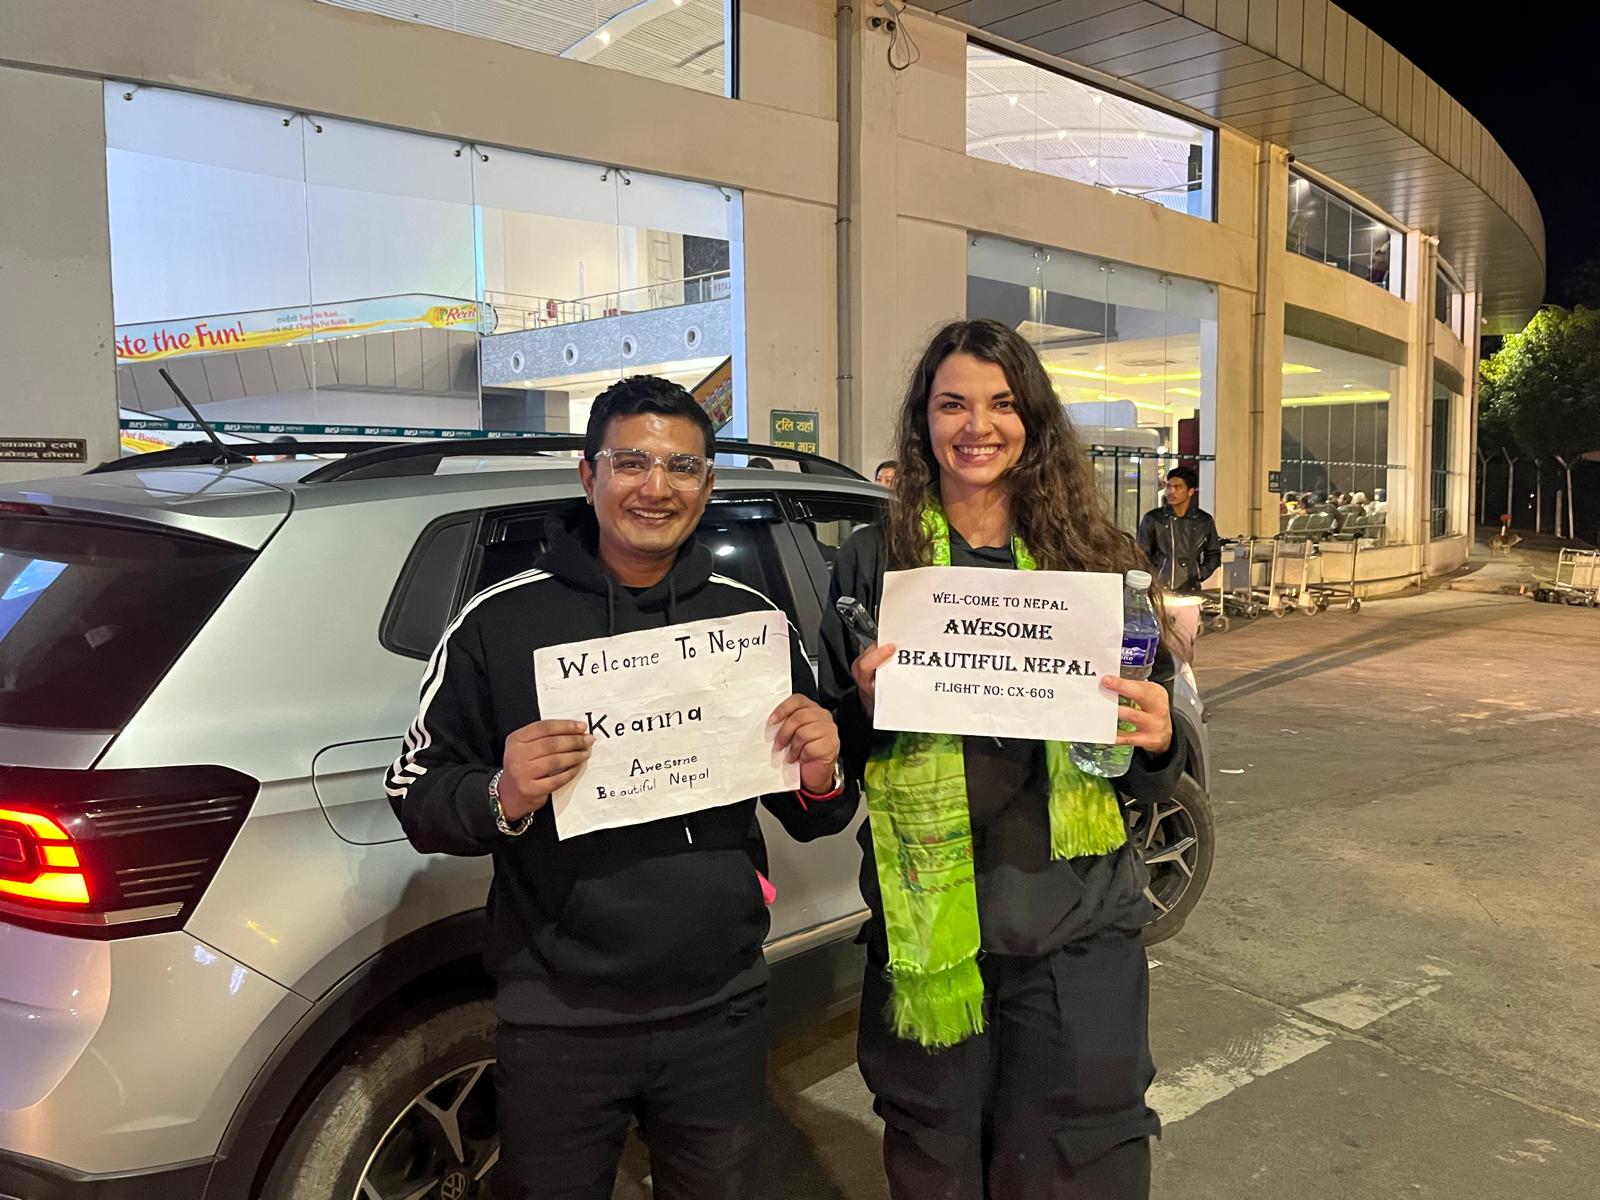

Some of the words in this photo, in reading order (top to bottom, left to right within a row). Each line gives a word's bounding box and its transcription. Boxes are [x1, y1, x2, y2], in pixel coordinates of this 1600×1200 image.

[152, 328, 192, 352] the
[195, 320, 247, 347] Fun!
[932, 592, 1000, 608] WEL-COME
[1002, 597, 1020, 608] TO
[1023, 598, 1069, 611] NEPAL
[943, 617, 1054, 641] AWESOME
[557, 649, 660, 680] Welcome
[675, 635, 697, 660] To
[708, 624, 768, 663] Nepal
[897, 649, 1018, 673] BEAUTIFUL
[1022, 656, 1098, 677] NEPAL
[934, 682, 981, 695] FLIGHT
[983, 685, 1005, 697] NO:
[1007, 686, 1056, 700] CX-603
[585, 706, 702, 739] Keanna
[629, 755, 698, 777] Awesome
[596, 779, 656, 800] Beautiful
[669, 768, 709, 789] Nepal
